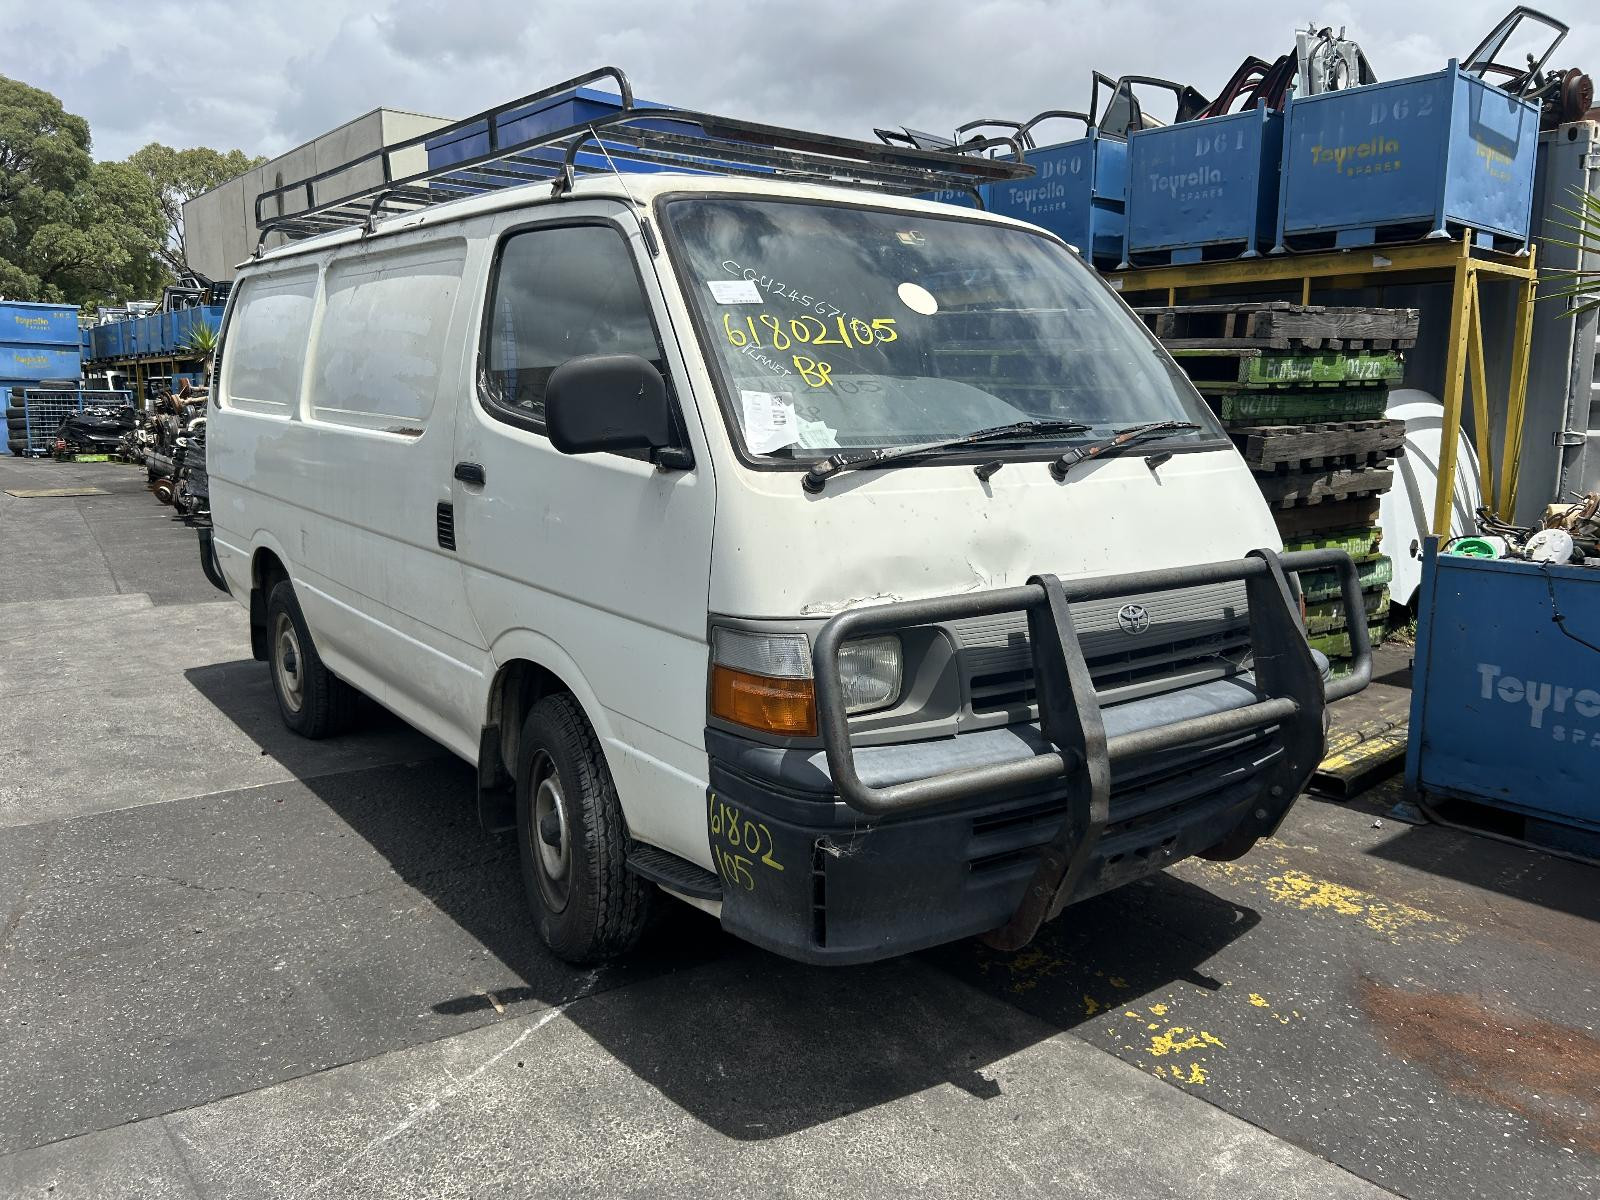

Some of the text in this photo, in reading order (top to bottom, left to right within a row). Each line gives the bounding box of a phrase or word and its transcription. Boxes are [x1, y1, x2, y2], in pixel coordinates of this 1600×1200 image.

[1369, 94, 1433, 125] D62
[1195, 130, 1244, 157] D61
[1041, 156, 1082, 179] D60
[710, 793, 784, 871] 61802
